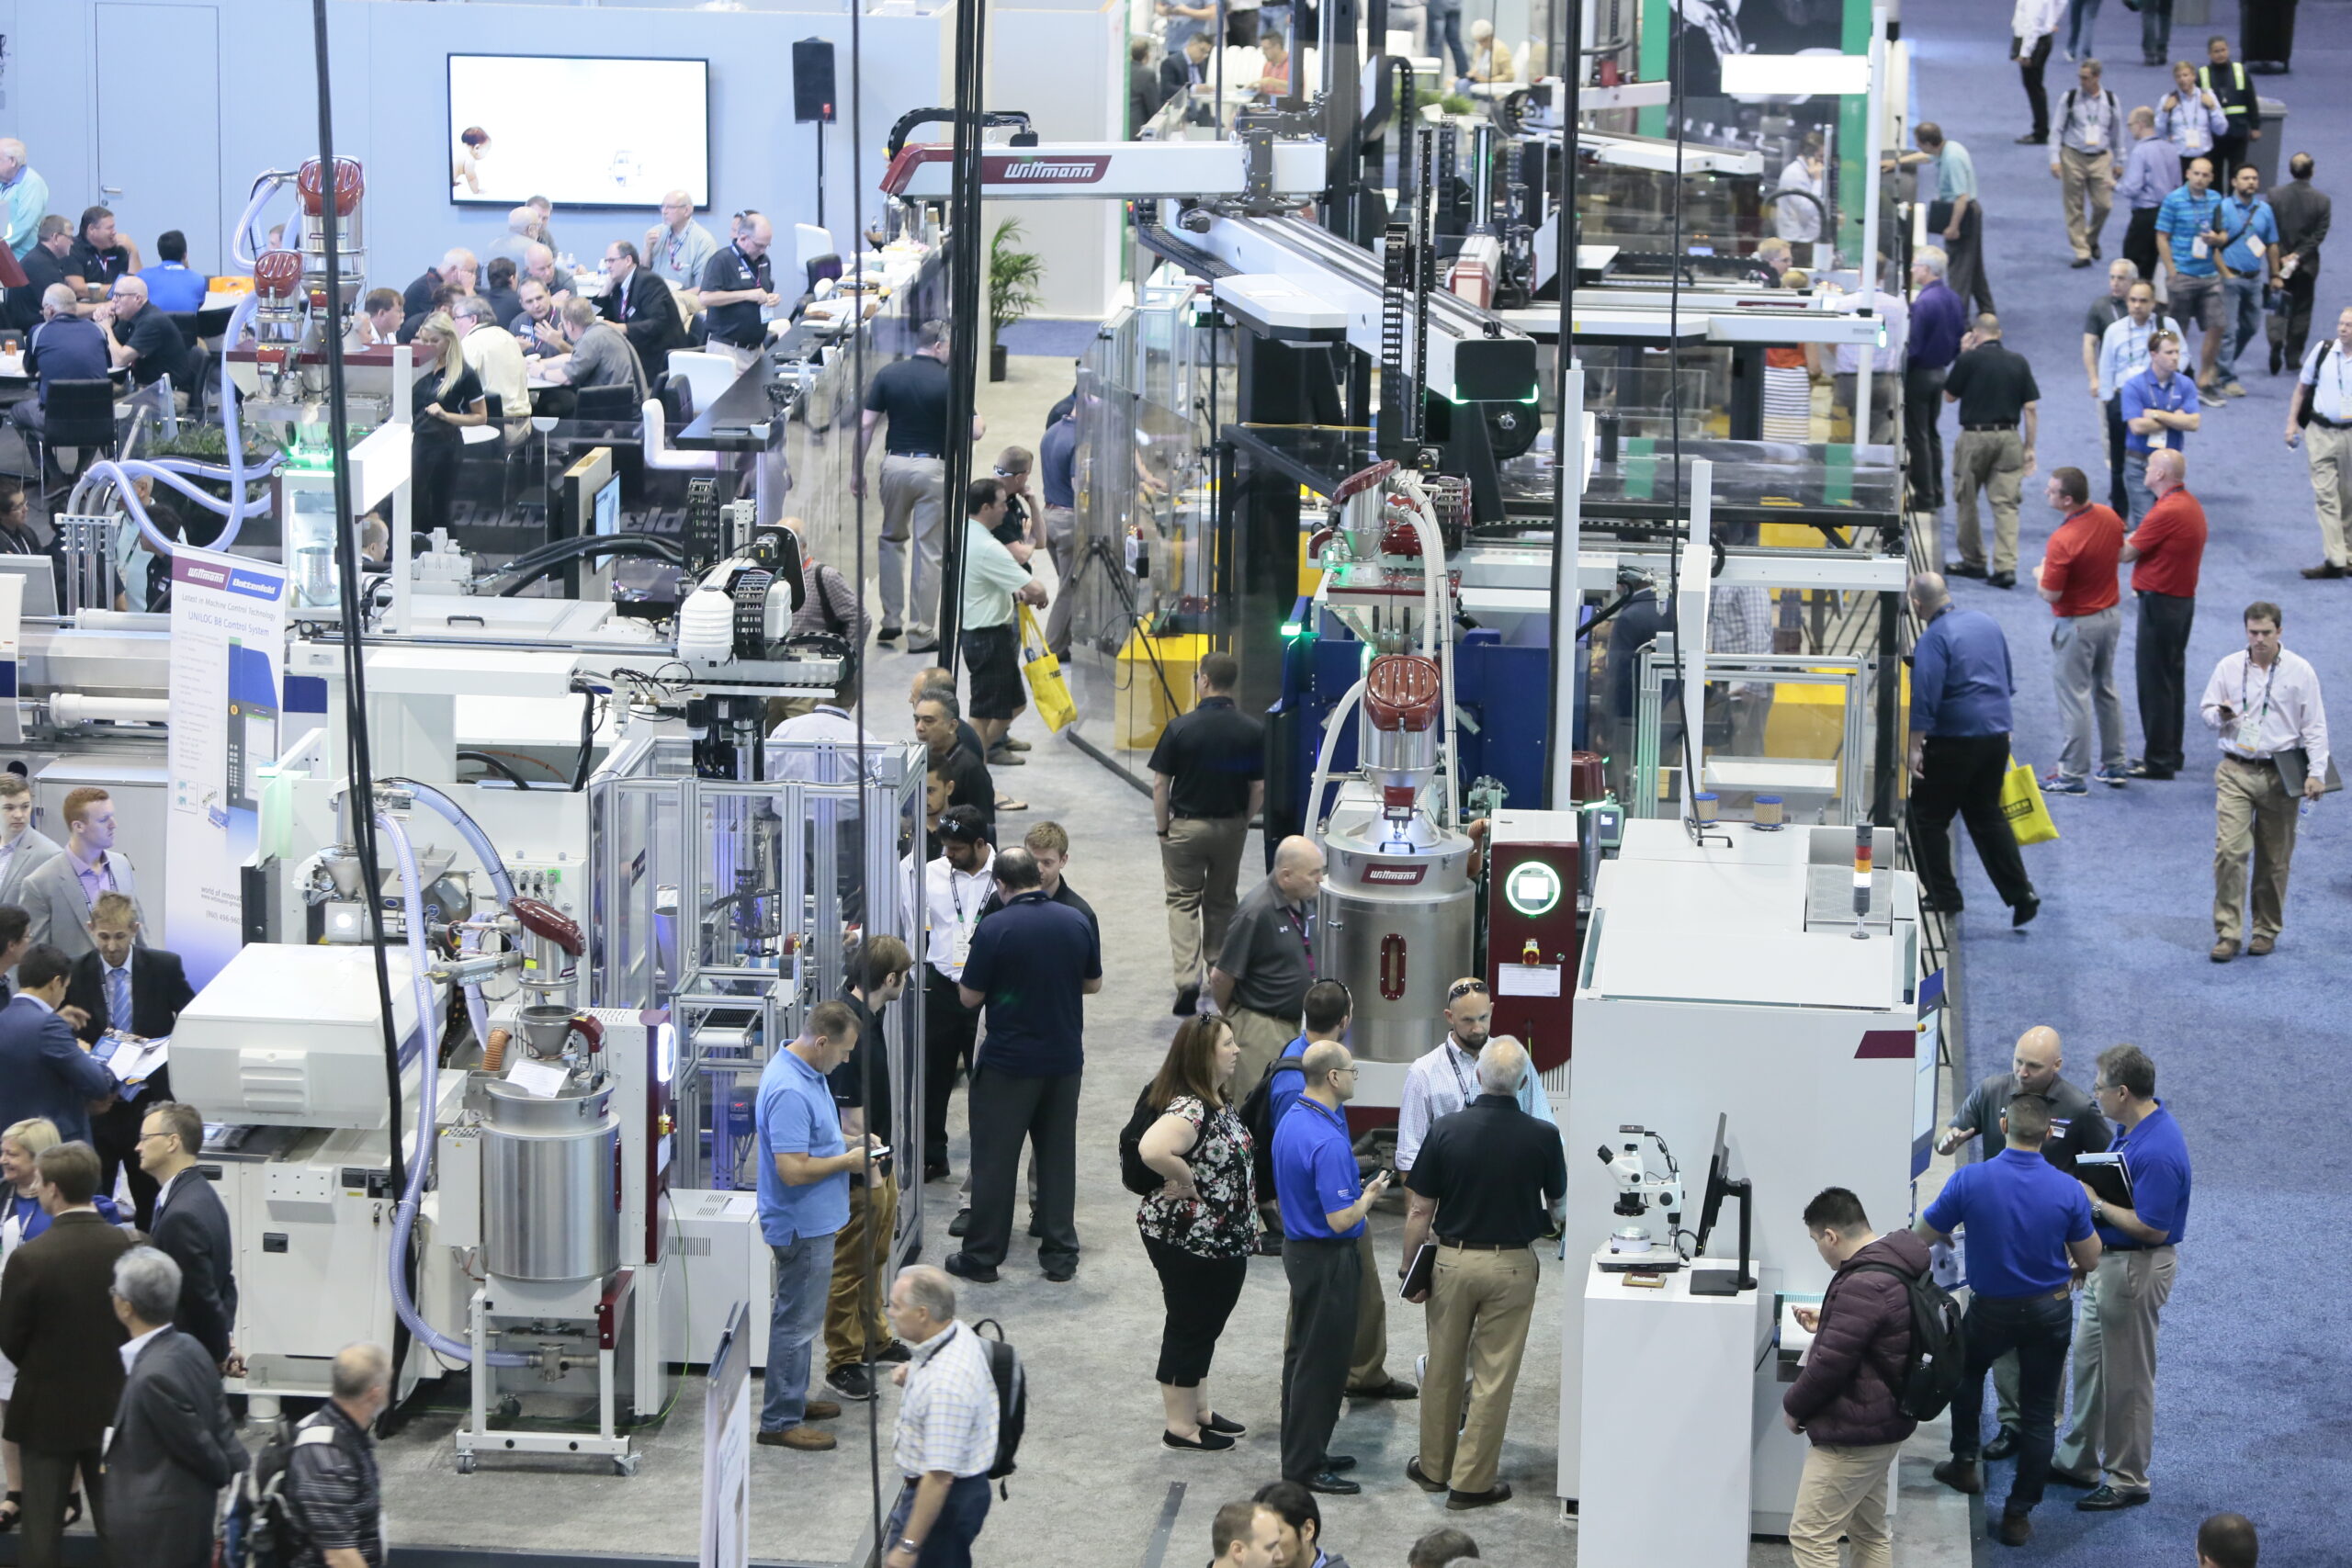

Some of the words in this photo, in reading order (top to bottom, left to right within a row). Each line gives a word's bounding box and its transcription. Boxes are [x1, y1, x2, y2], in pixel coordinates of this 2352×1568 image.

[1003, 161, 1097, 178] Wittmann
[187, 567, 225, 583] Wittmann
[232, 578, 277, 594] Battenfeld
[182, 593, 198, 604] Latest
[205, 598, 226, 610] Machine
[227, 603, 247, 614] Control
[248, 607, 277, 622] Technology
[187, 611, 213, 624] UNILOG
[223, 618, 247, 631] Control
[248, 625, 270, 637] System
[1369, 870, 1418, 880] Wittmann
